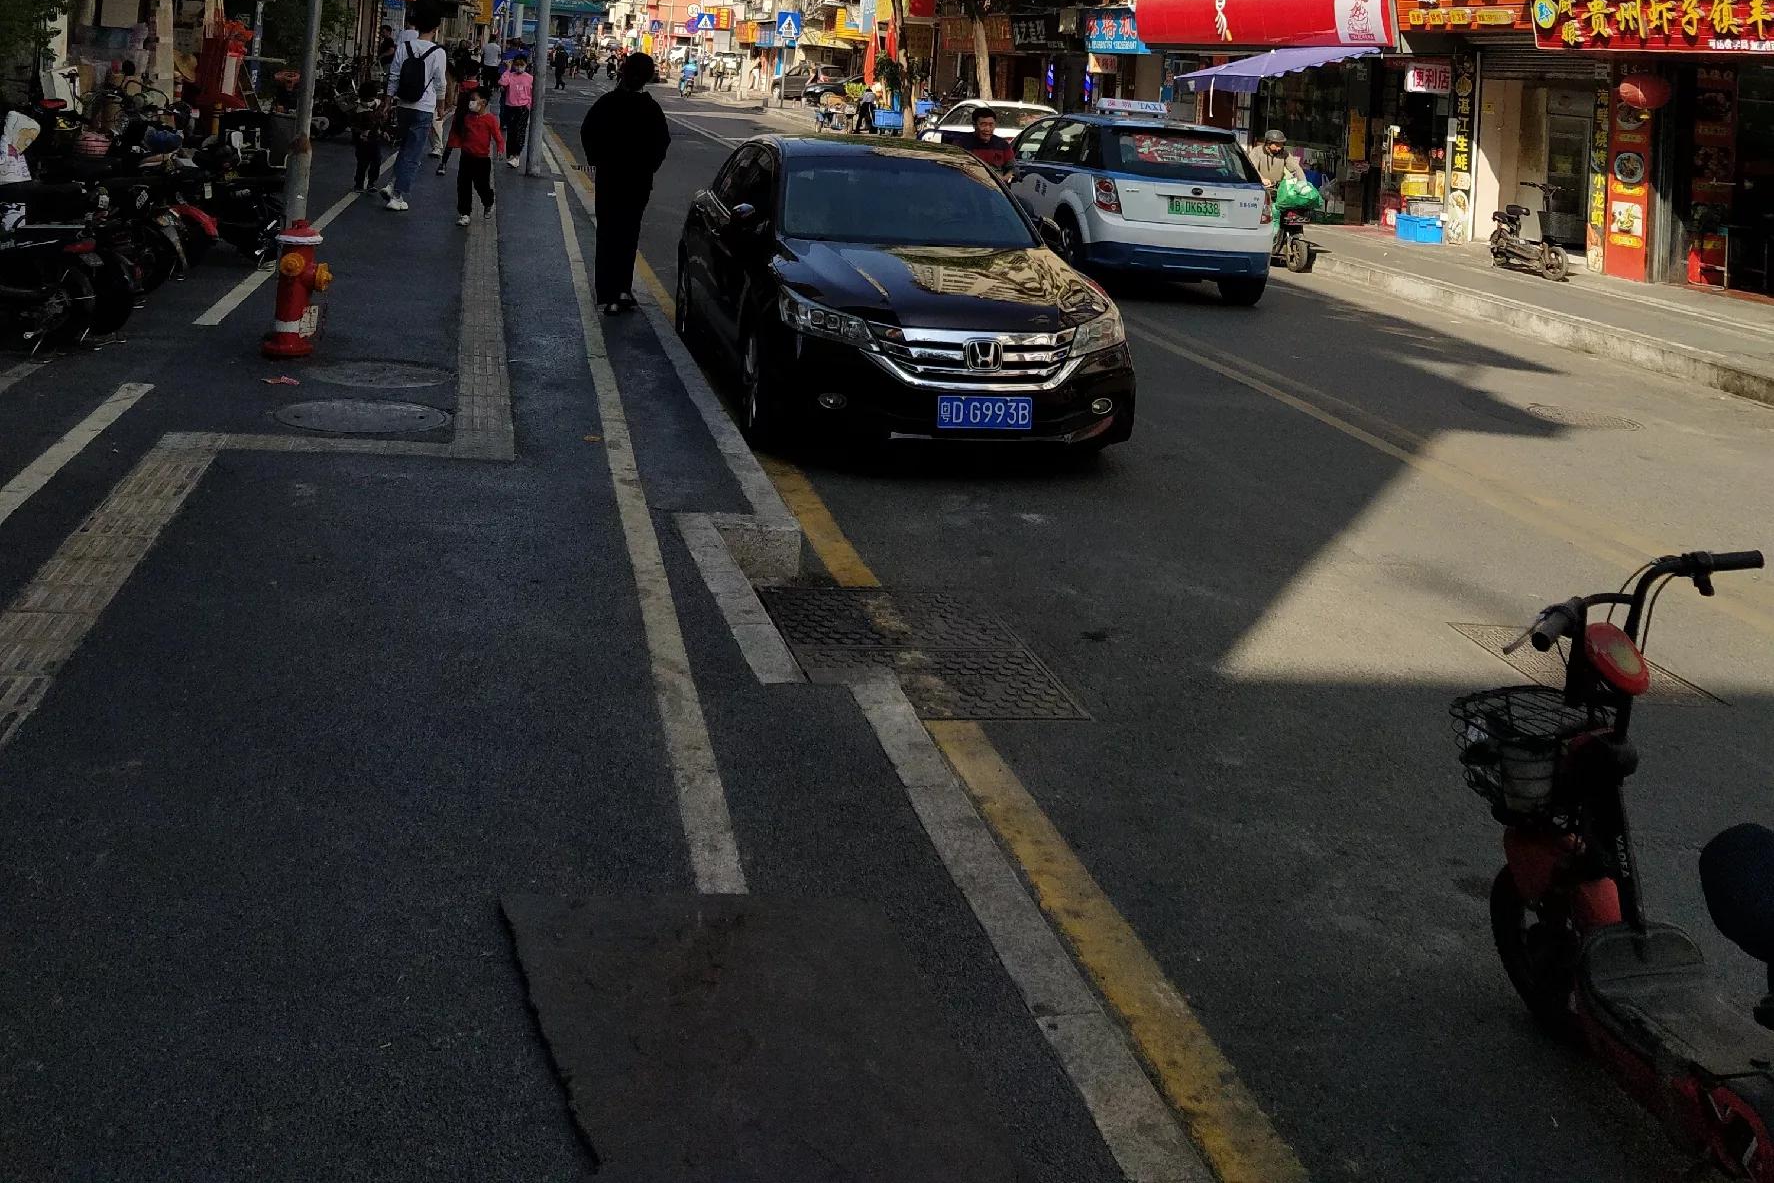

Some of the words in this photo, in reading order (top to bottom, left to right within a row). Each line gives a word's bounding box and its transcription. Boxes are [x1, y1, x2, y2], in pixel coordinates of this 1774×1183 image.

[1412, 67, 1450, 91] 便利店
[1137, 102, 1164, 112] TAXI
